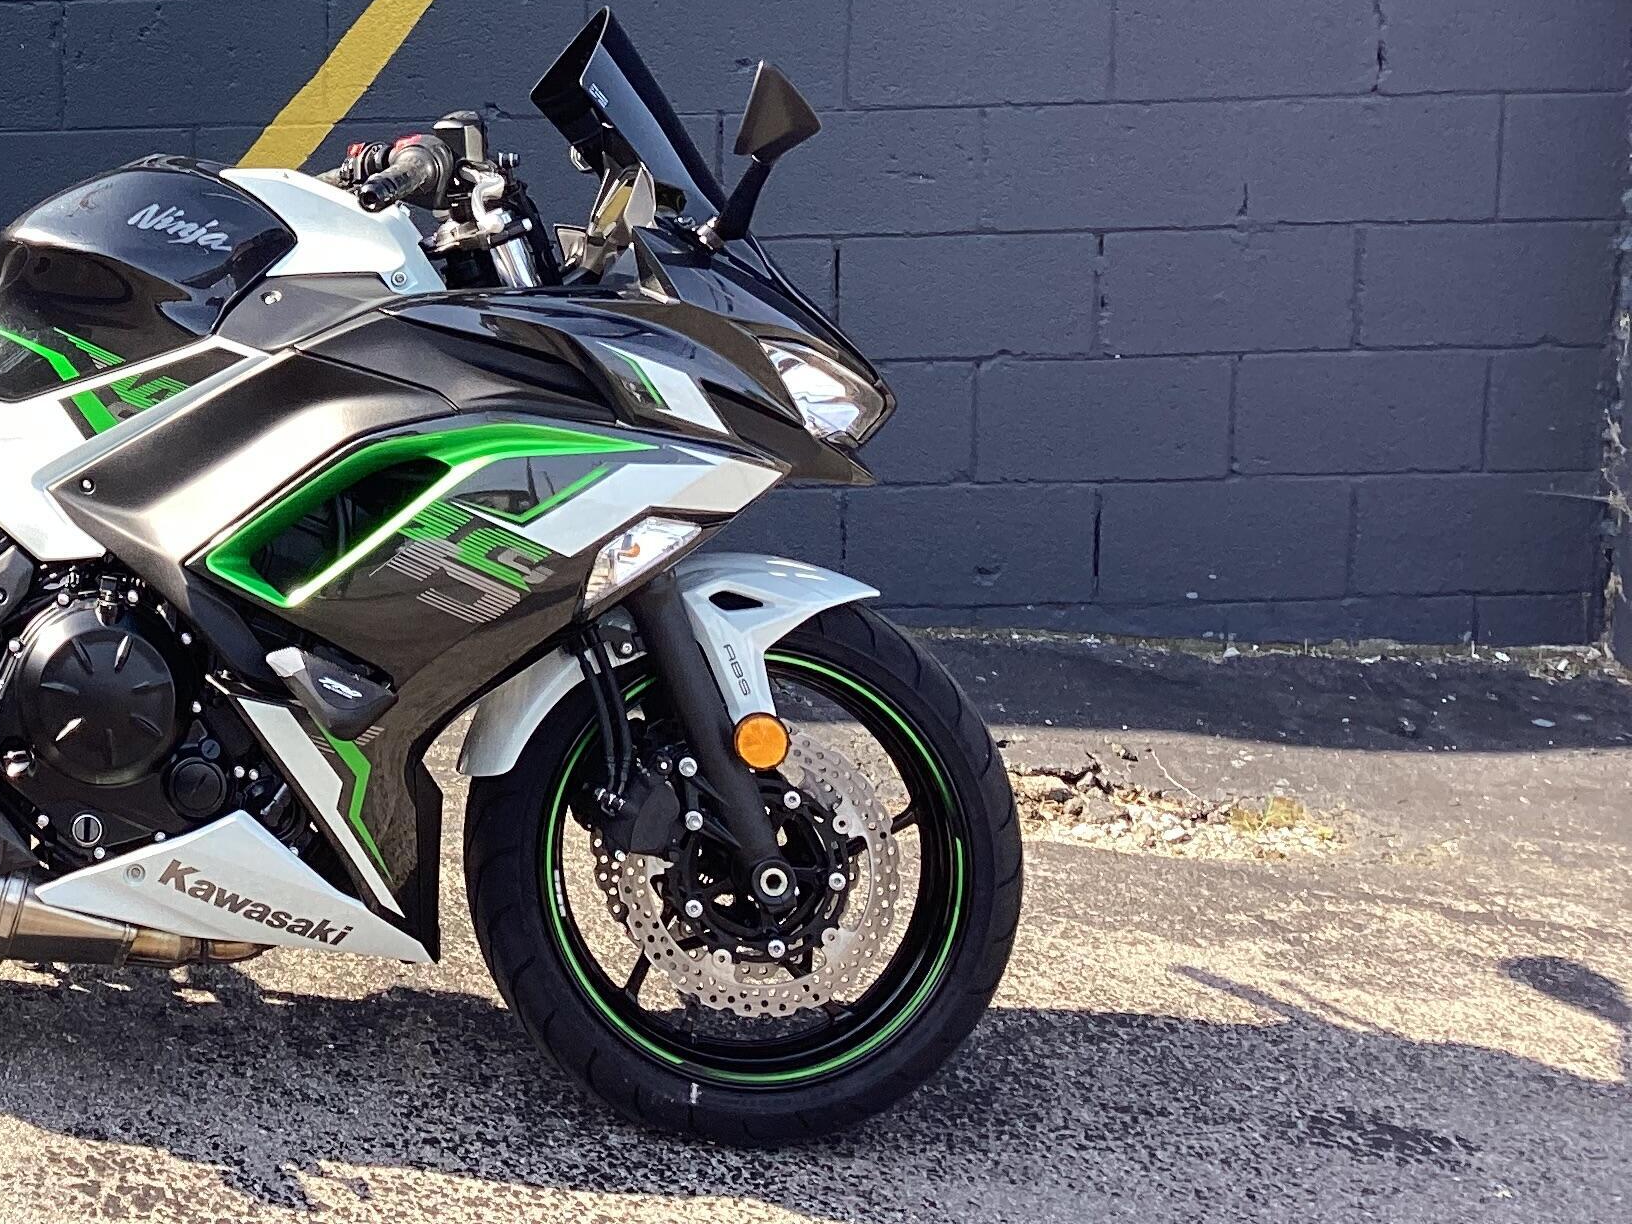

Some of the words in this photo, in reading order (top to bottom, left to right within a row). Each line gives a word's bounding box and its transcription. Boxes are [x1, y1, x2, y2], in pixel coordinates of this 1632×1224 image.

[127, 203, 233, 255] Ninja
[723, 643, 751, 696] ABS
[156, 858, 355, 947] Kawasaki
